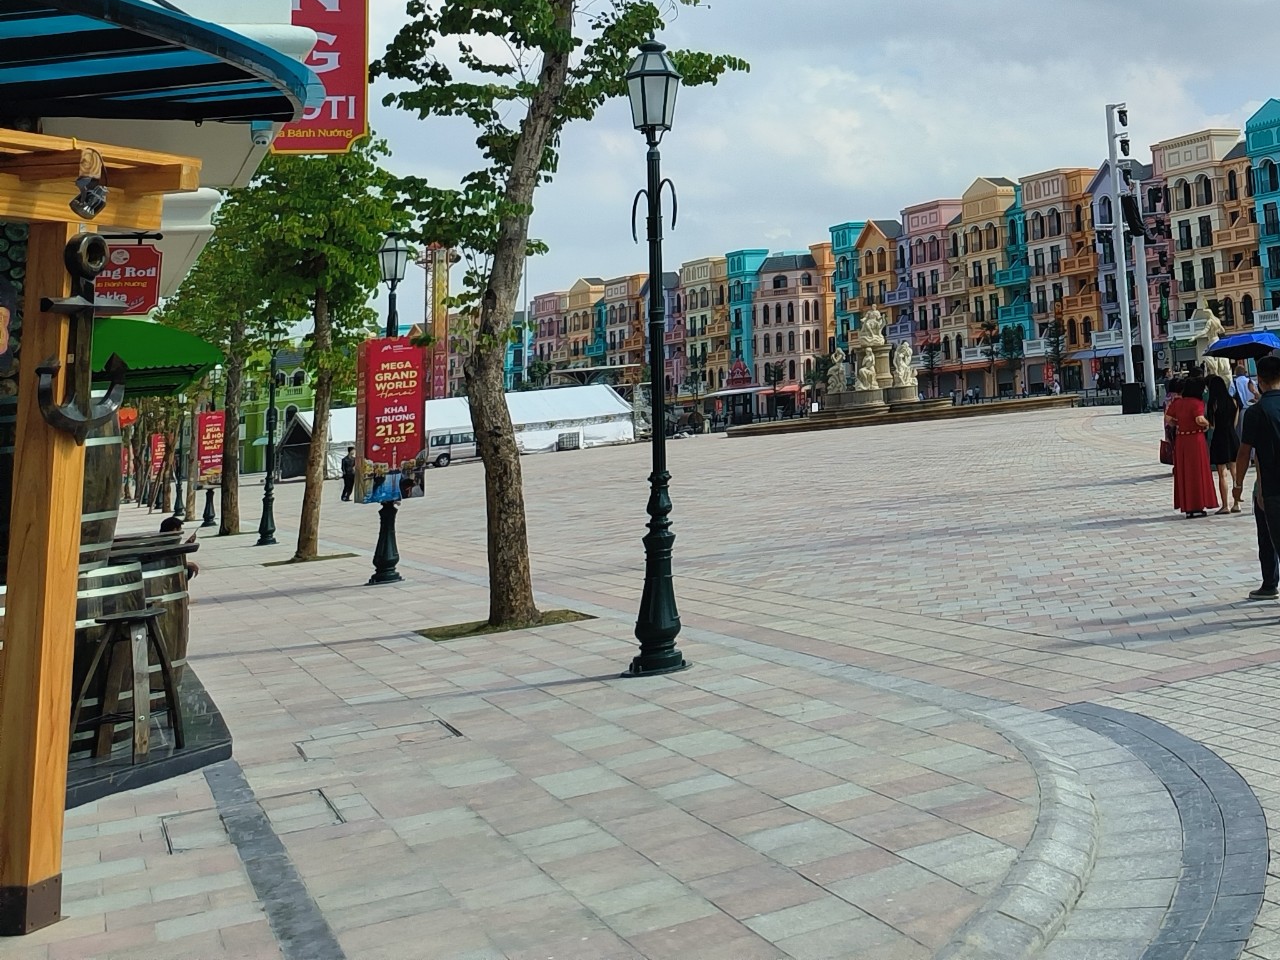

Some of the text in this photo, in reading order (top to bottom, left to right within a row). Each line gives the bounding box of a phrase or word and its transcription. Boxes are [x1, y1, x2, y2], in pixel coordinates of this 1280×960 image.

[381, 361, 412, 371] MEGA
[375, 370, 418, 382] GRAND
[375, 380, 417, 391] WORLD
[384, 405, 408, 414] KHAI
[375, 422, 415, 437] 21.12
[384, 435, 407, 444] 2023
